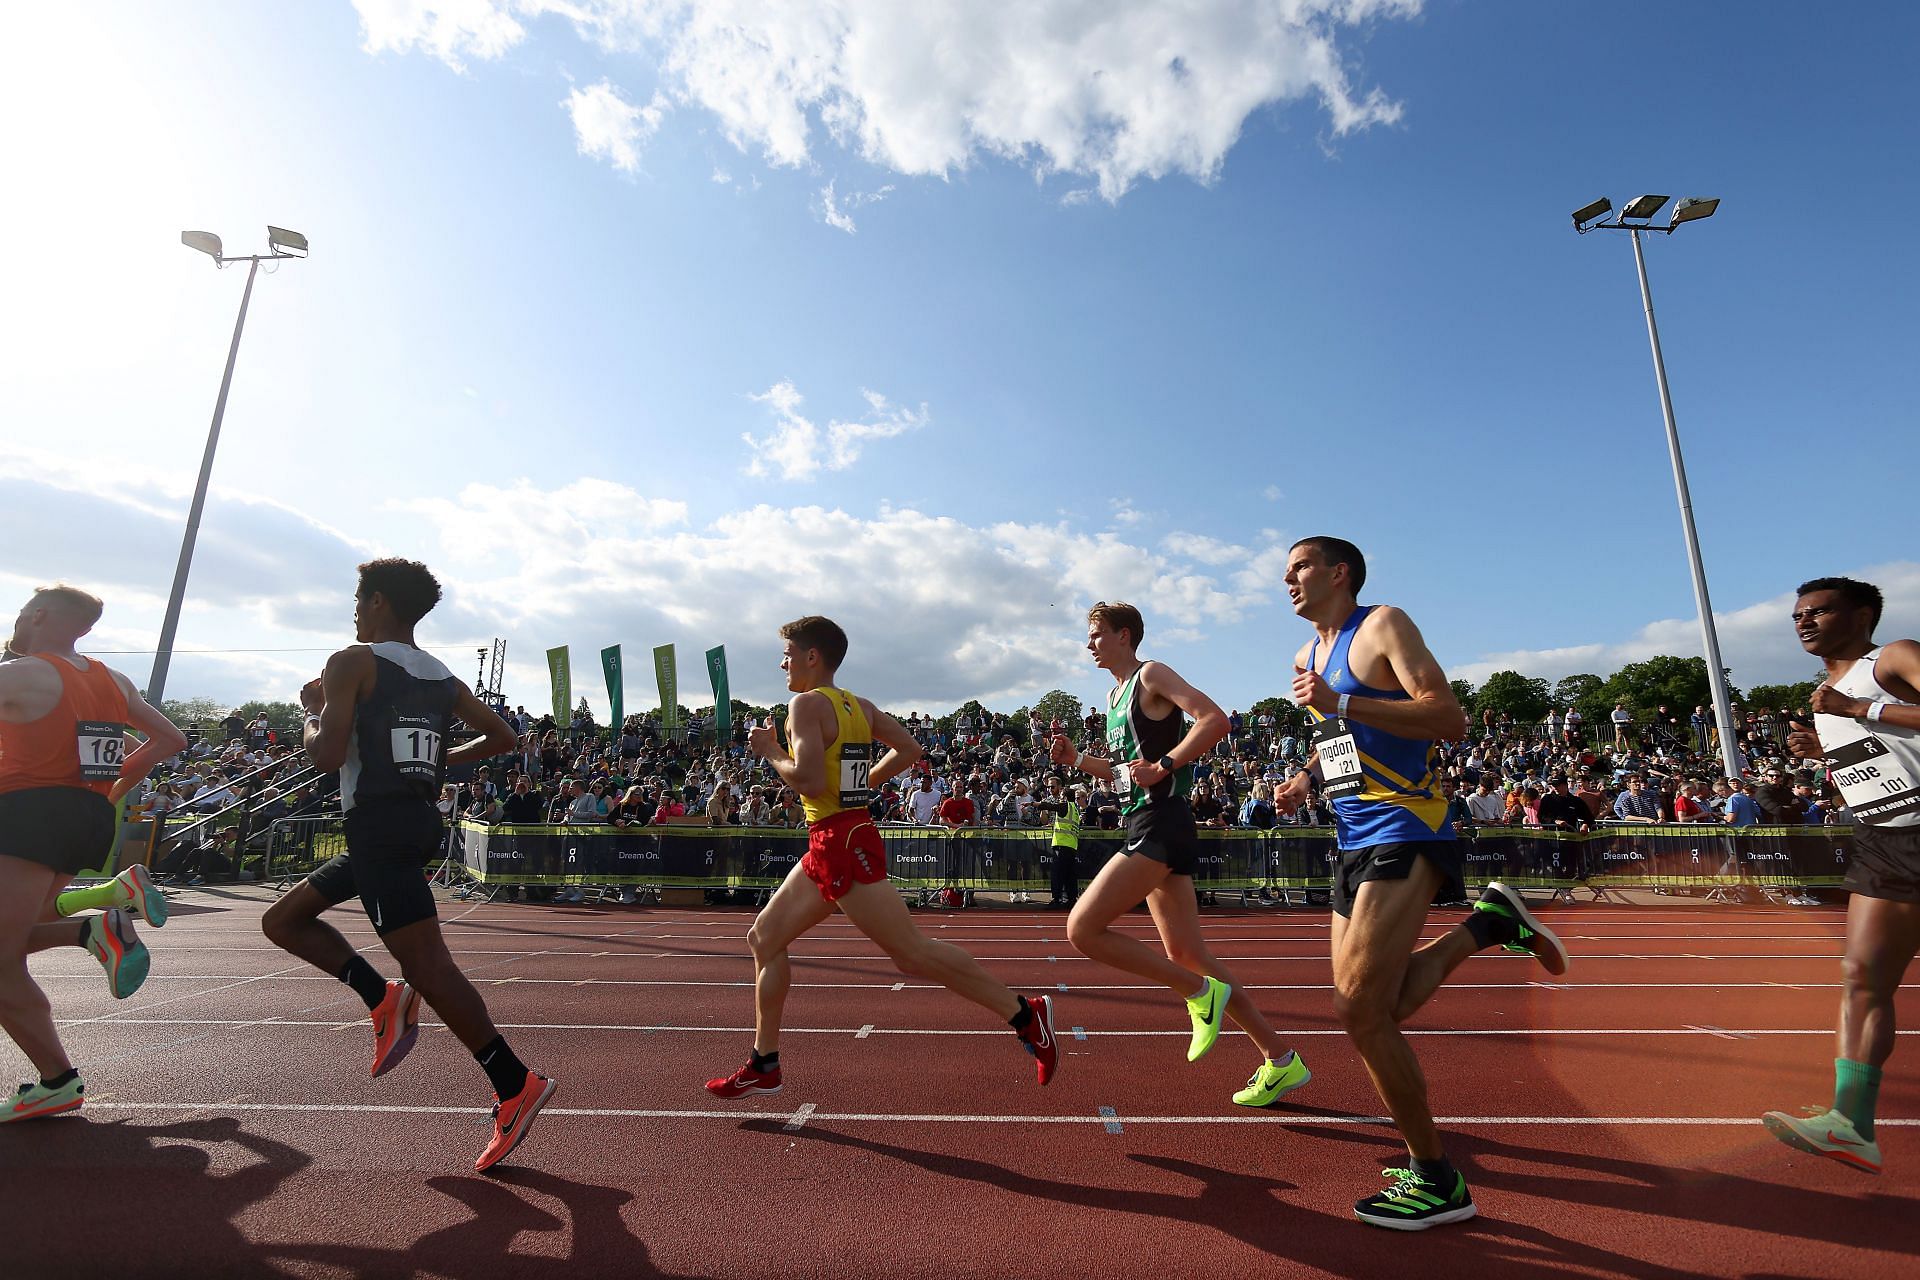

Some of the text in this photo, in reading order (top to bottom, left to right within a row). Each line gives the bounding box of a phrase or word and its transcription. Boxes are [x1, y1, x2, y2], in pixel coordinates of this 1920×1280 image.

[1339, 759, 1355, 775] 121
[1834, 766, 1881, 789] Abebe
[1880, 777, 1908, 794] 101
[488, 850, 511, 859] Dream
[618, 851, 660, 860] Dream On.
[759, 853, 786, 862] Dream
[896, 854, 923, 863] Dream
[1466, 852, 1507, 862] Dream On.
[1603, 851, 1645, 860] Dream On.
[1747, 852, 1790, 860] Dream On.
[1209, 855, 1225, 864] On.
